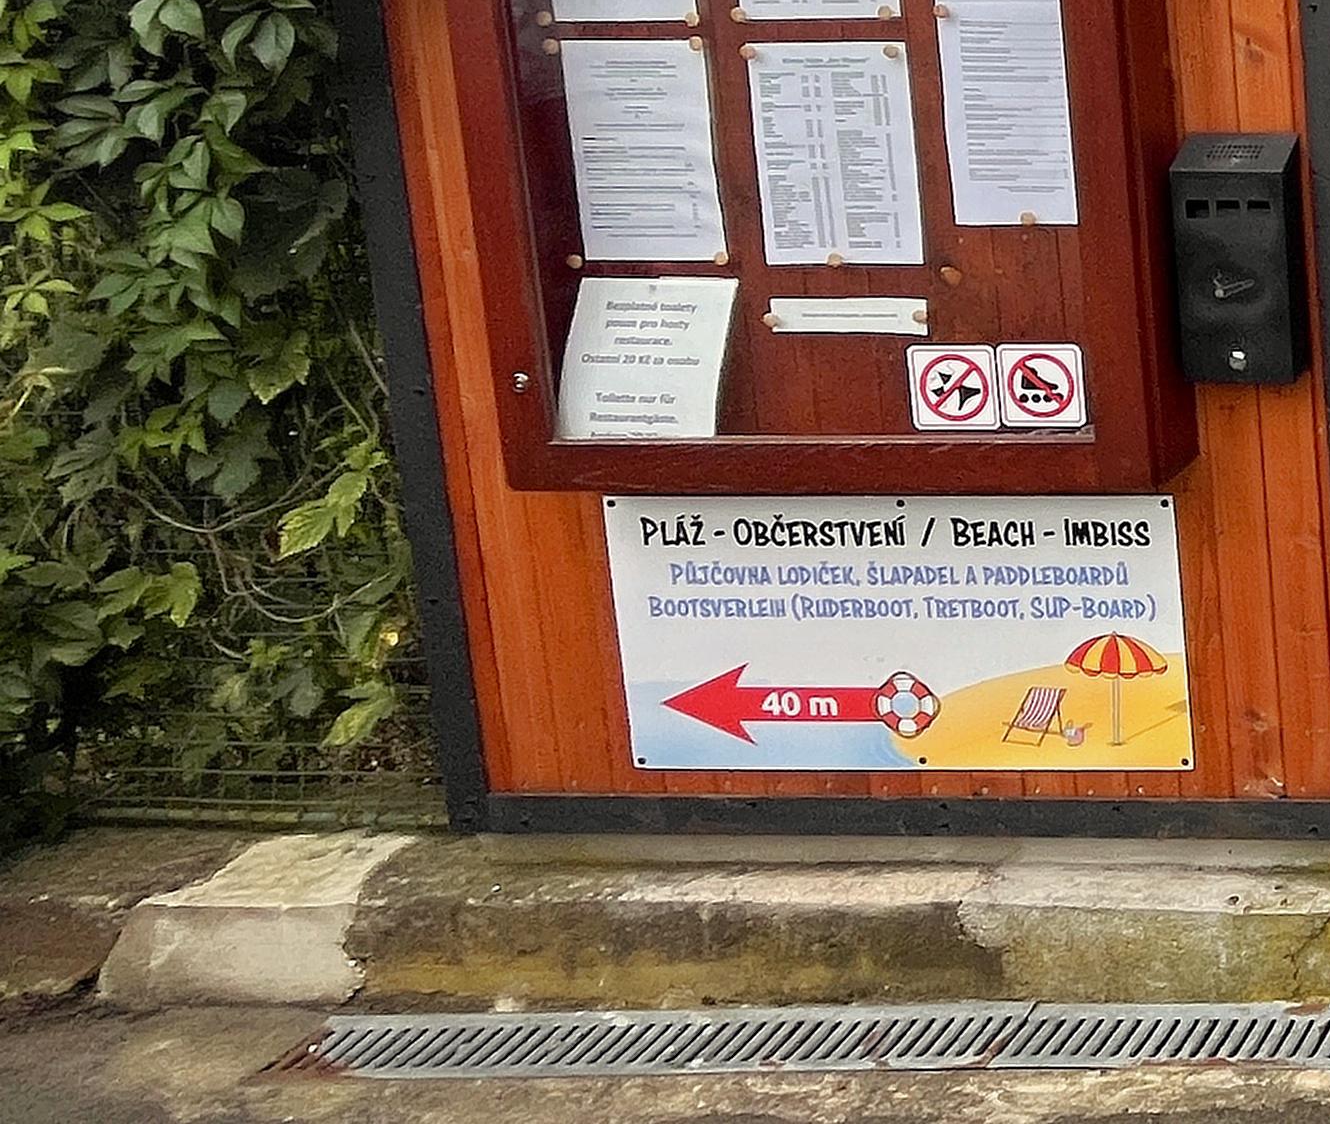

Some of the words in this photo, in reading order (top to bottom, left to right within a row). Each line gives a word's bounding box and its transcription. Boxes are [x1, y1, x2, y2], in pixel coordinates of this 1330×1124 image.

[640, 514, 706, 546] PLÁŽ
[713, 529, 726, 538] -
[733, 514, 906, 547] OBČERSTVENÍ
[921, 517, 936, 547] /
[950, 517, 1035, 547] BEACH
[1064, 518, 1151, 546] IMBISS
[670, 561, 772, 585] PŮJČOVNA
[777, 561, 861, 587] LODIČEK,
[867, 561, 961, 585] ŠLAPADEL
[965, 566, 978, 585] A
[983, 561, 1129, 585] PADDLEBOARDŮ
[648, 596, 787, 618] BOOTSVERLEIH
[791, 594, 919, 621] (RUDERBOOT,
[923, 596, 1025, 620] TRETBOOT,
[1030, 594, 1157, 621] SUP-BOARD)
[761, 691, 801, 716] 40
[809, 697, 838, 716] m
